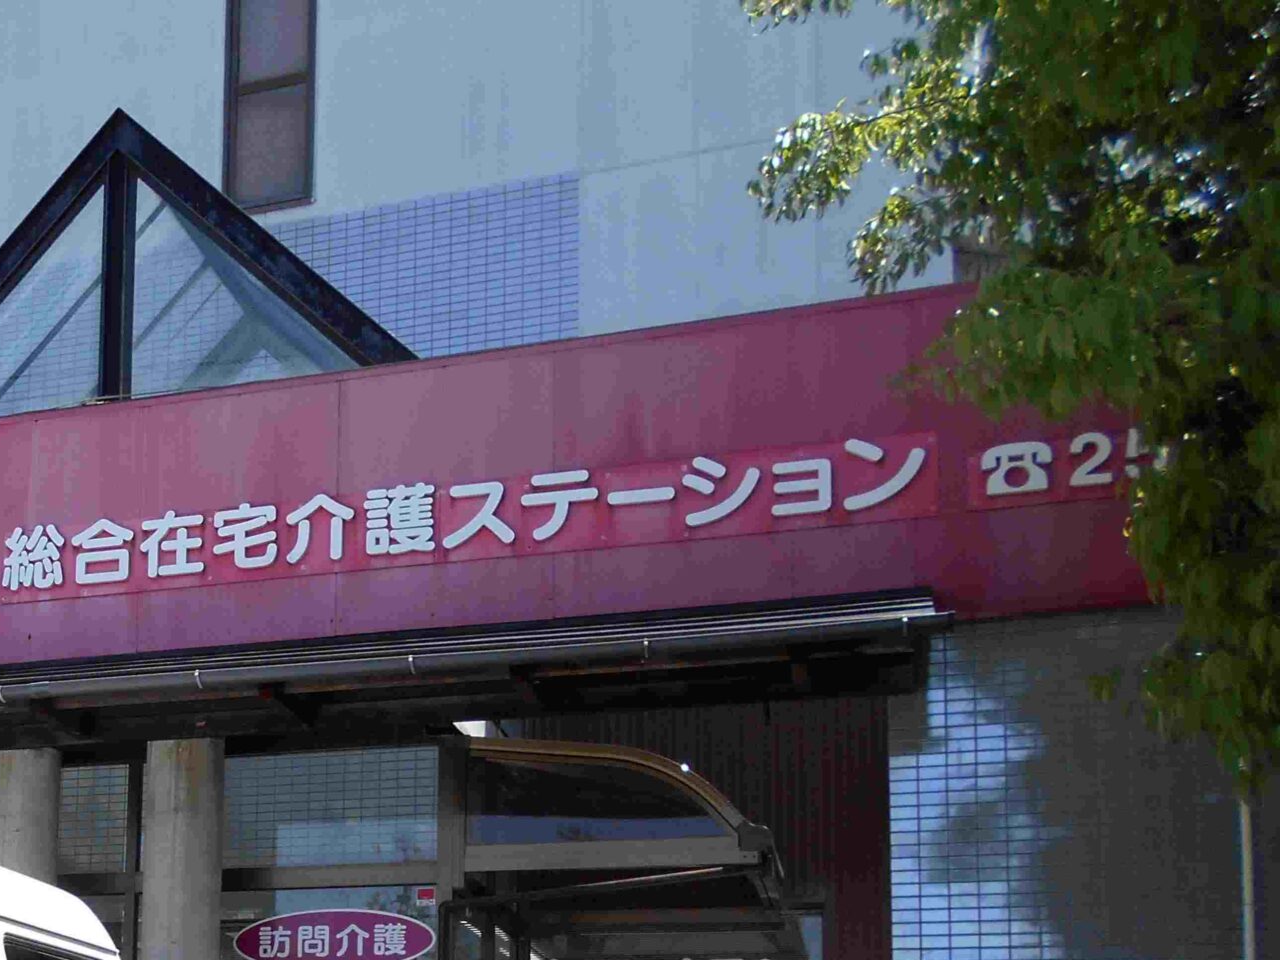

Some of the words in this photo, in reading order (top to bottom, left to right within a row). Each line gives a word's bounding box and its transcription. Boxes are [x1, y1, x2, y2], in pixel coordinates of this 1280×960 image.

[1, 438, 926, 592] 総合在宅介護ステーション
[258, 923, 407, 958] 訪問介護
